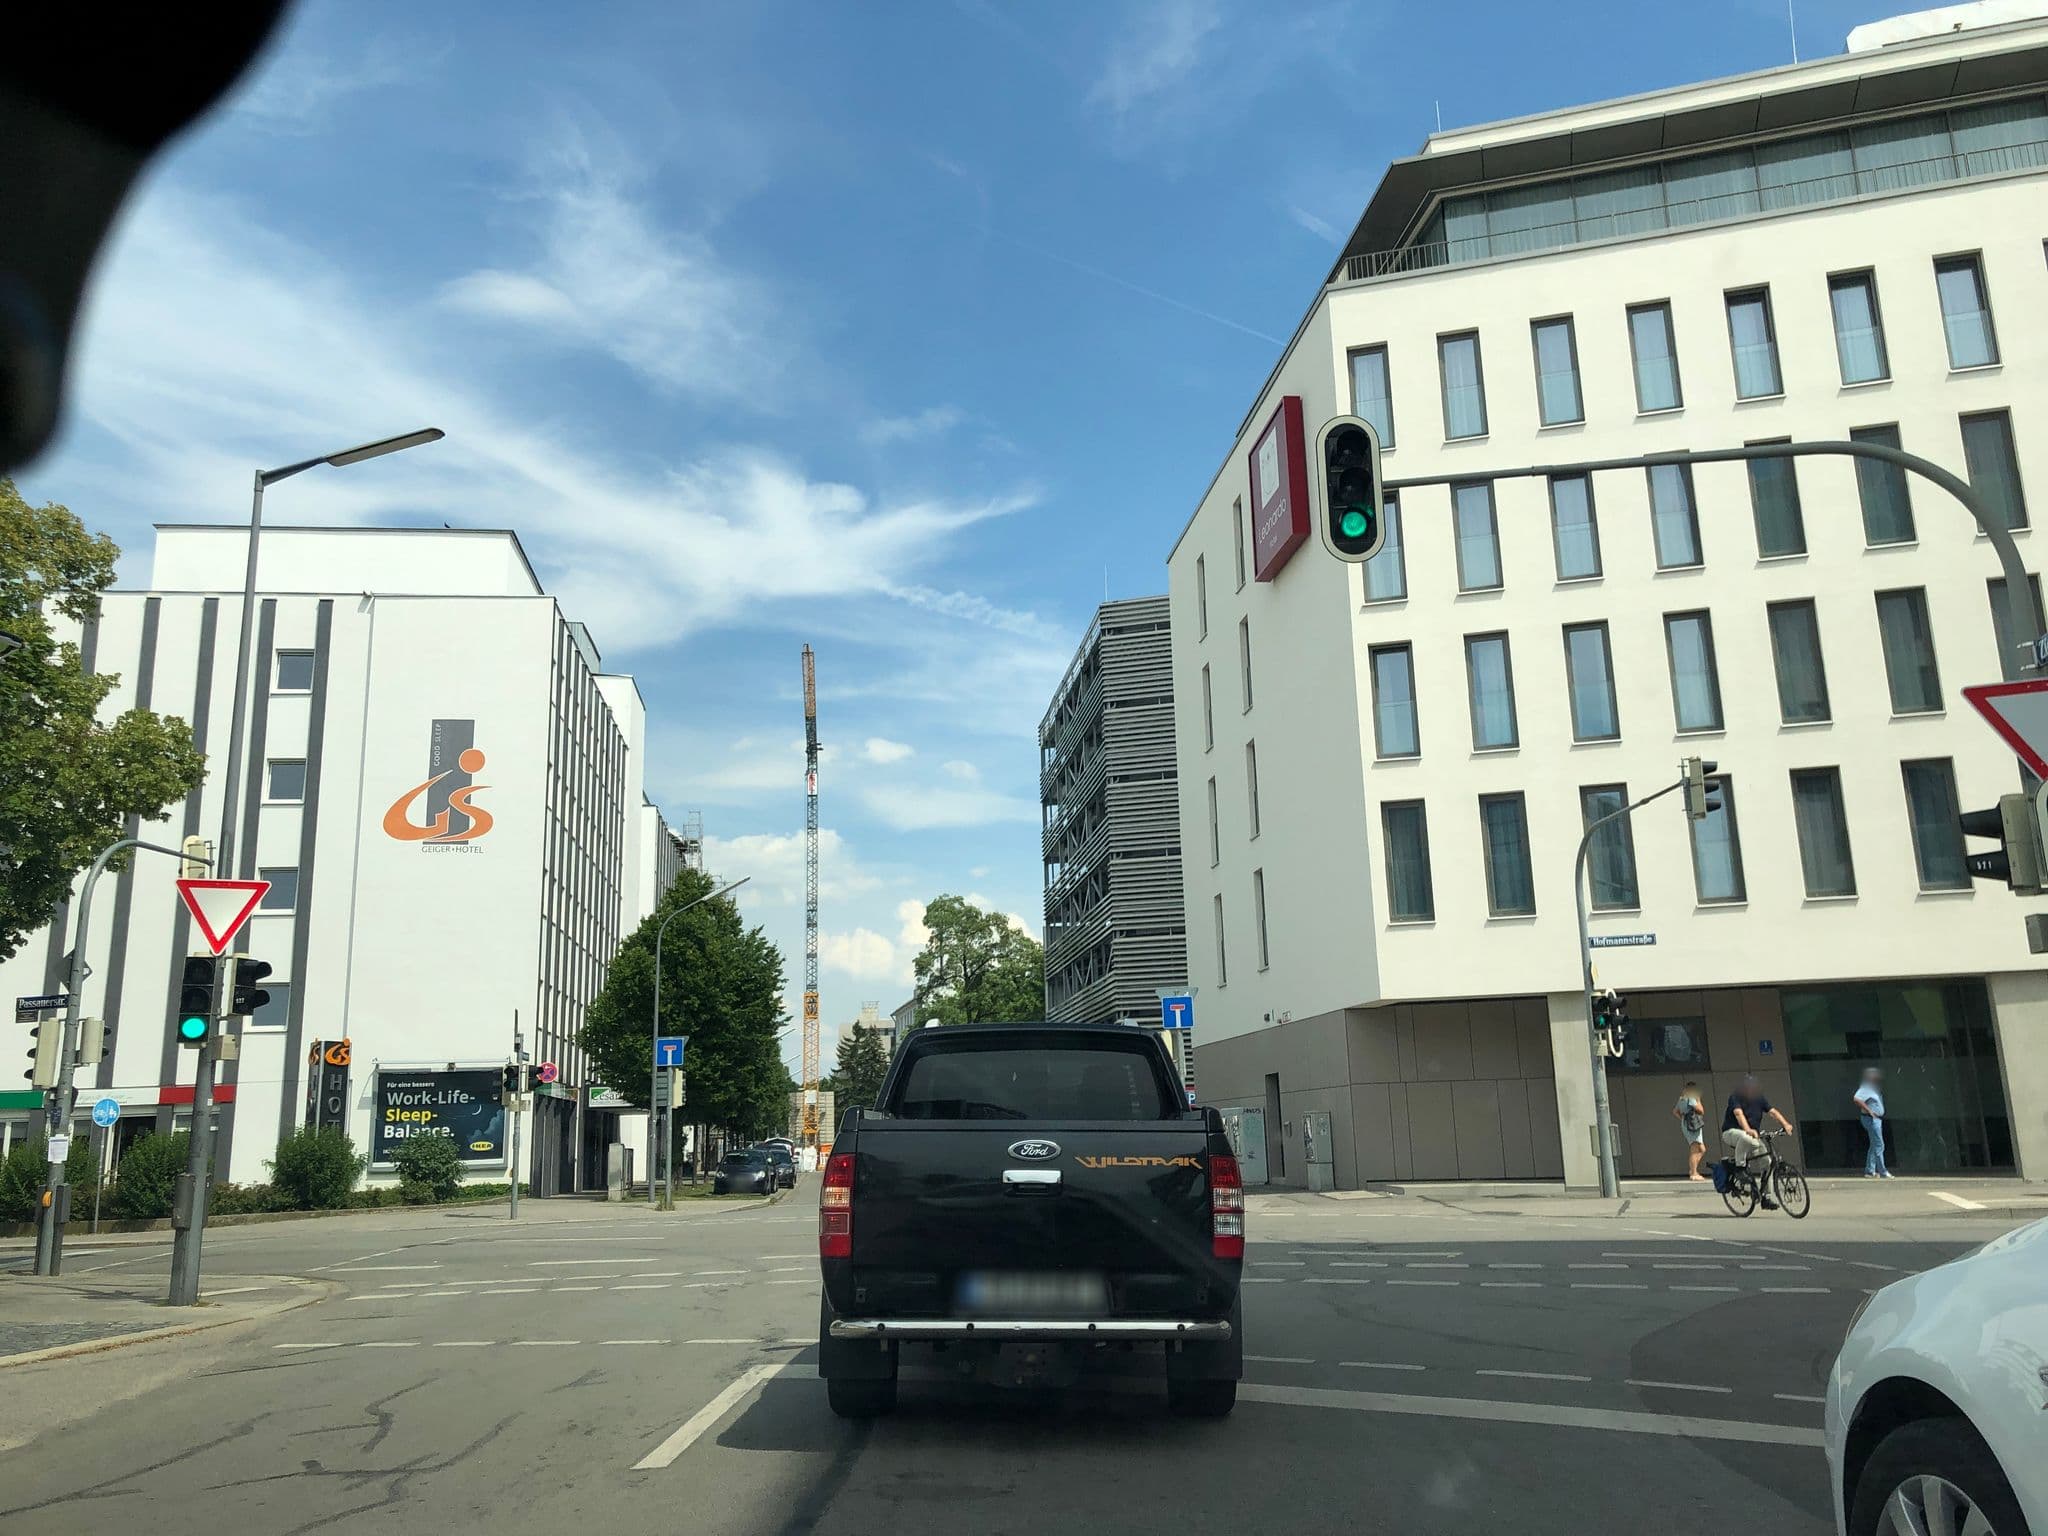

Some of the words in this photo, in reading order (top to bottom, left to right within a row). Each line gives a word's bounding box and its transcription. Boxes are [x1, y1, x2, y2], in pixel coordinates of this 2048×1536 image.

[433, 745, 441, 767] GOOD
[1593, 934, 1653, 947] Hofmannstraße
[387, 1090, 476, 1105] Work-Life-
[1188, 1093, 1196, 1105] P
[385, 1108, 438, 1125] Sleep-
[1020, 1143, 1049, 1157] Ford
[1074, 1156, 1203, 1169] WILDTRAK
